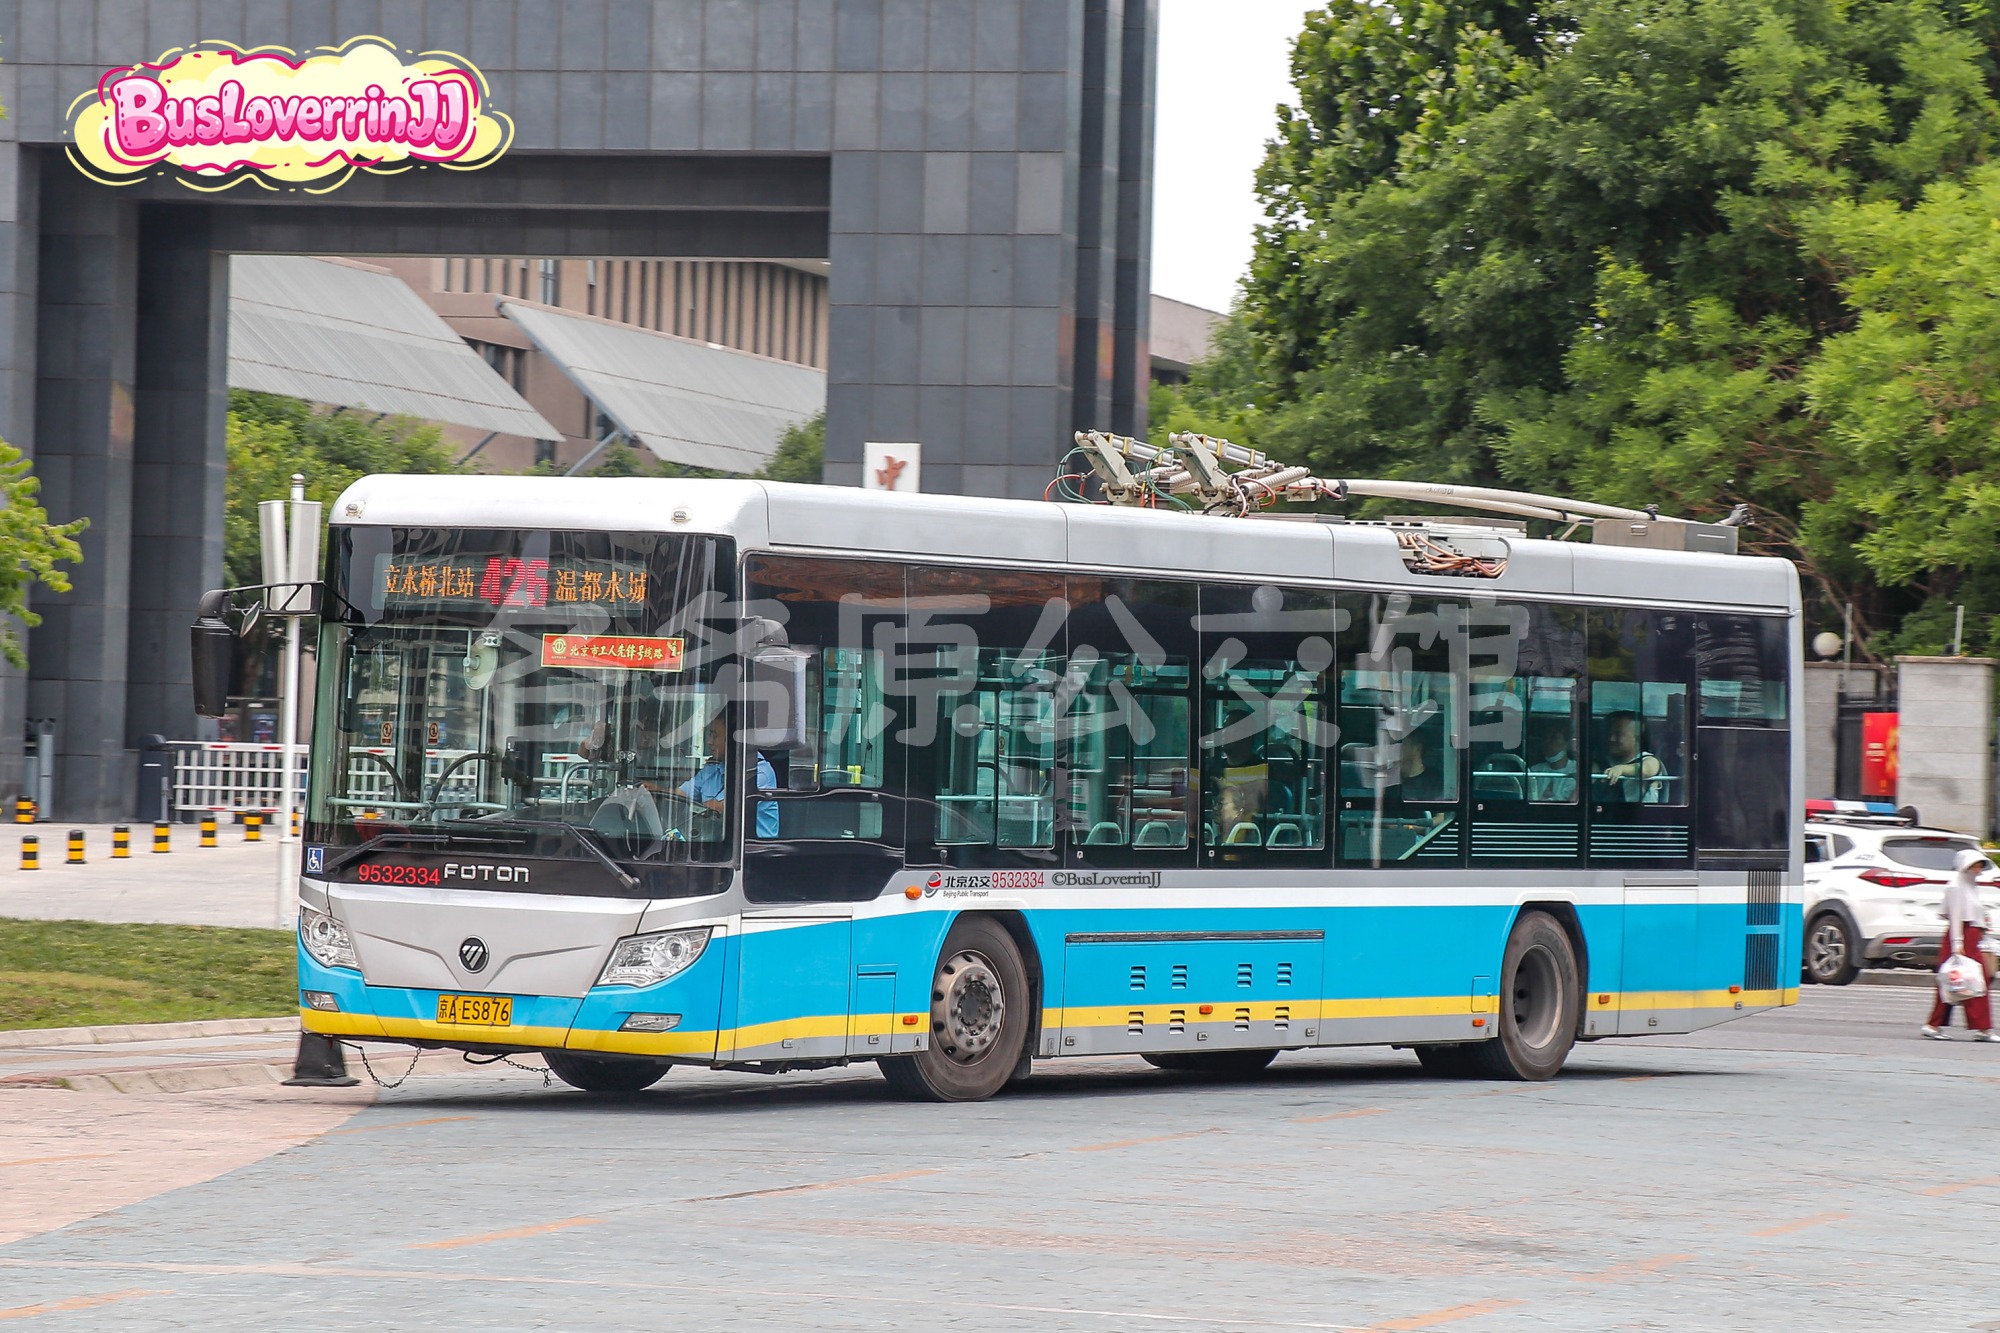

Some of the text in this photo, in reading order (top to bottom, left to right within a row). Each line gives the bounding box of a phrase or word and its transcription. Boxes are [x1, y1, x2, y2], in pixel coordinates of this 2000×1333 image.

[382, 558, 648, 607] 立水桥北站 426 温都水城
[569, 644, 664, 661] 北京市工人先锋号线路
[358, 863, 530, 886] 9532334 FOTON
[944, 871, 1045, 888] 北京公交 9532334
[943, 890, 989, 898] Beijing Public Transport
